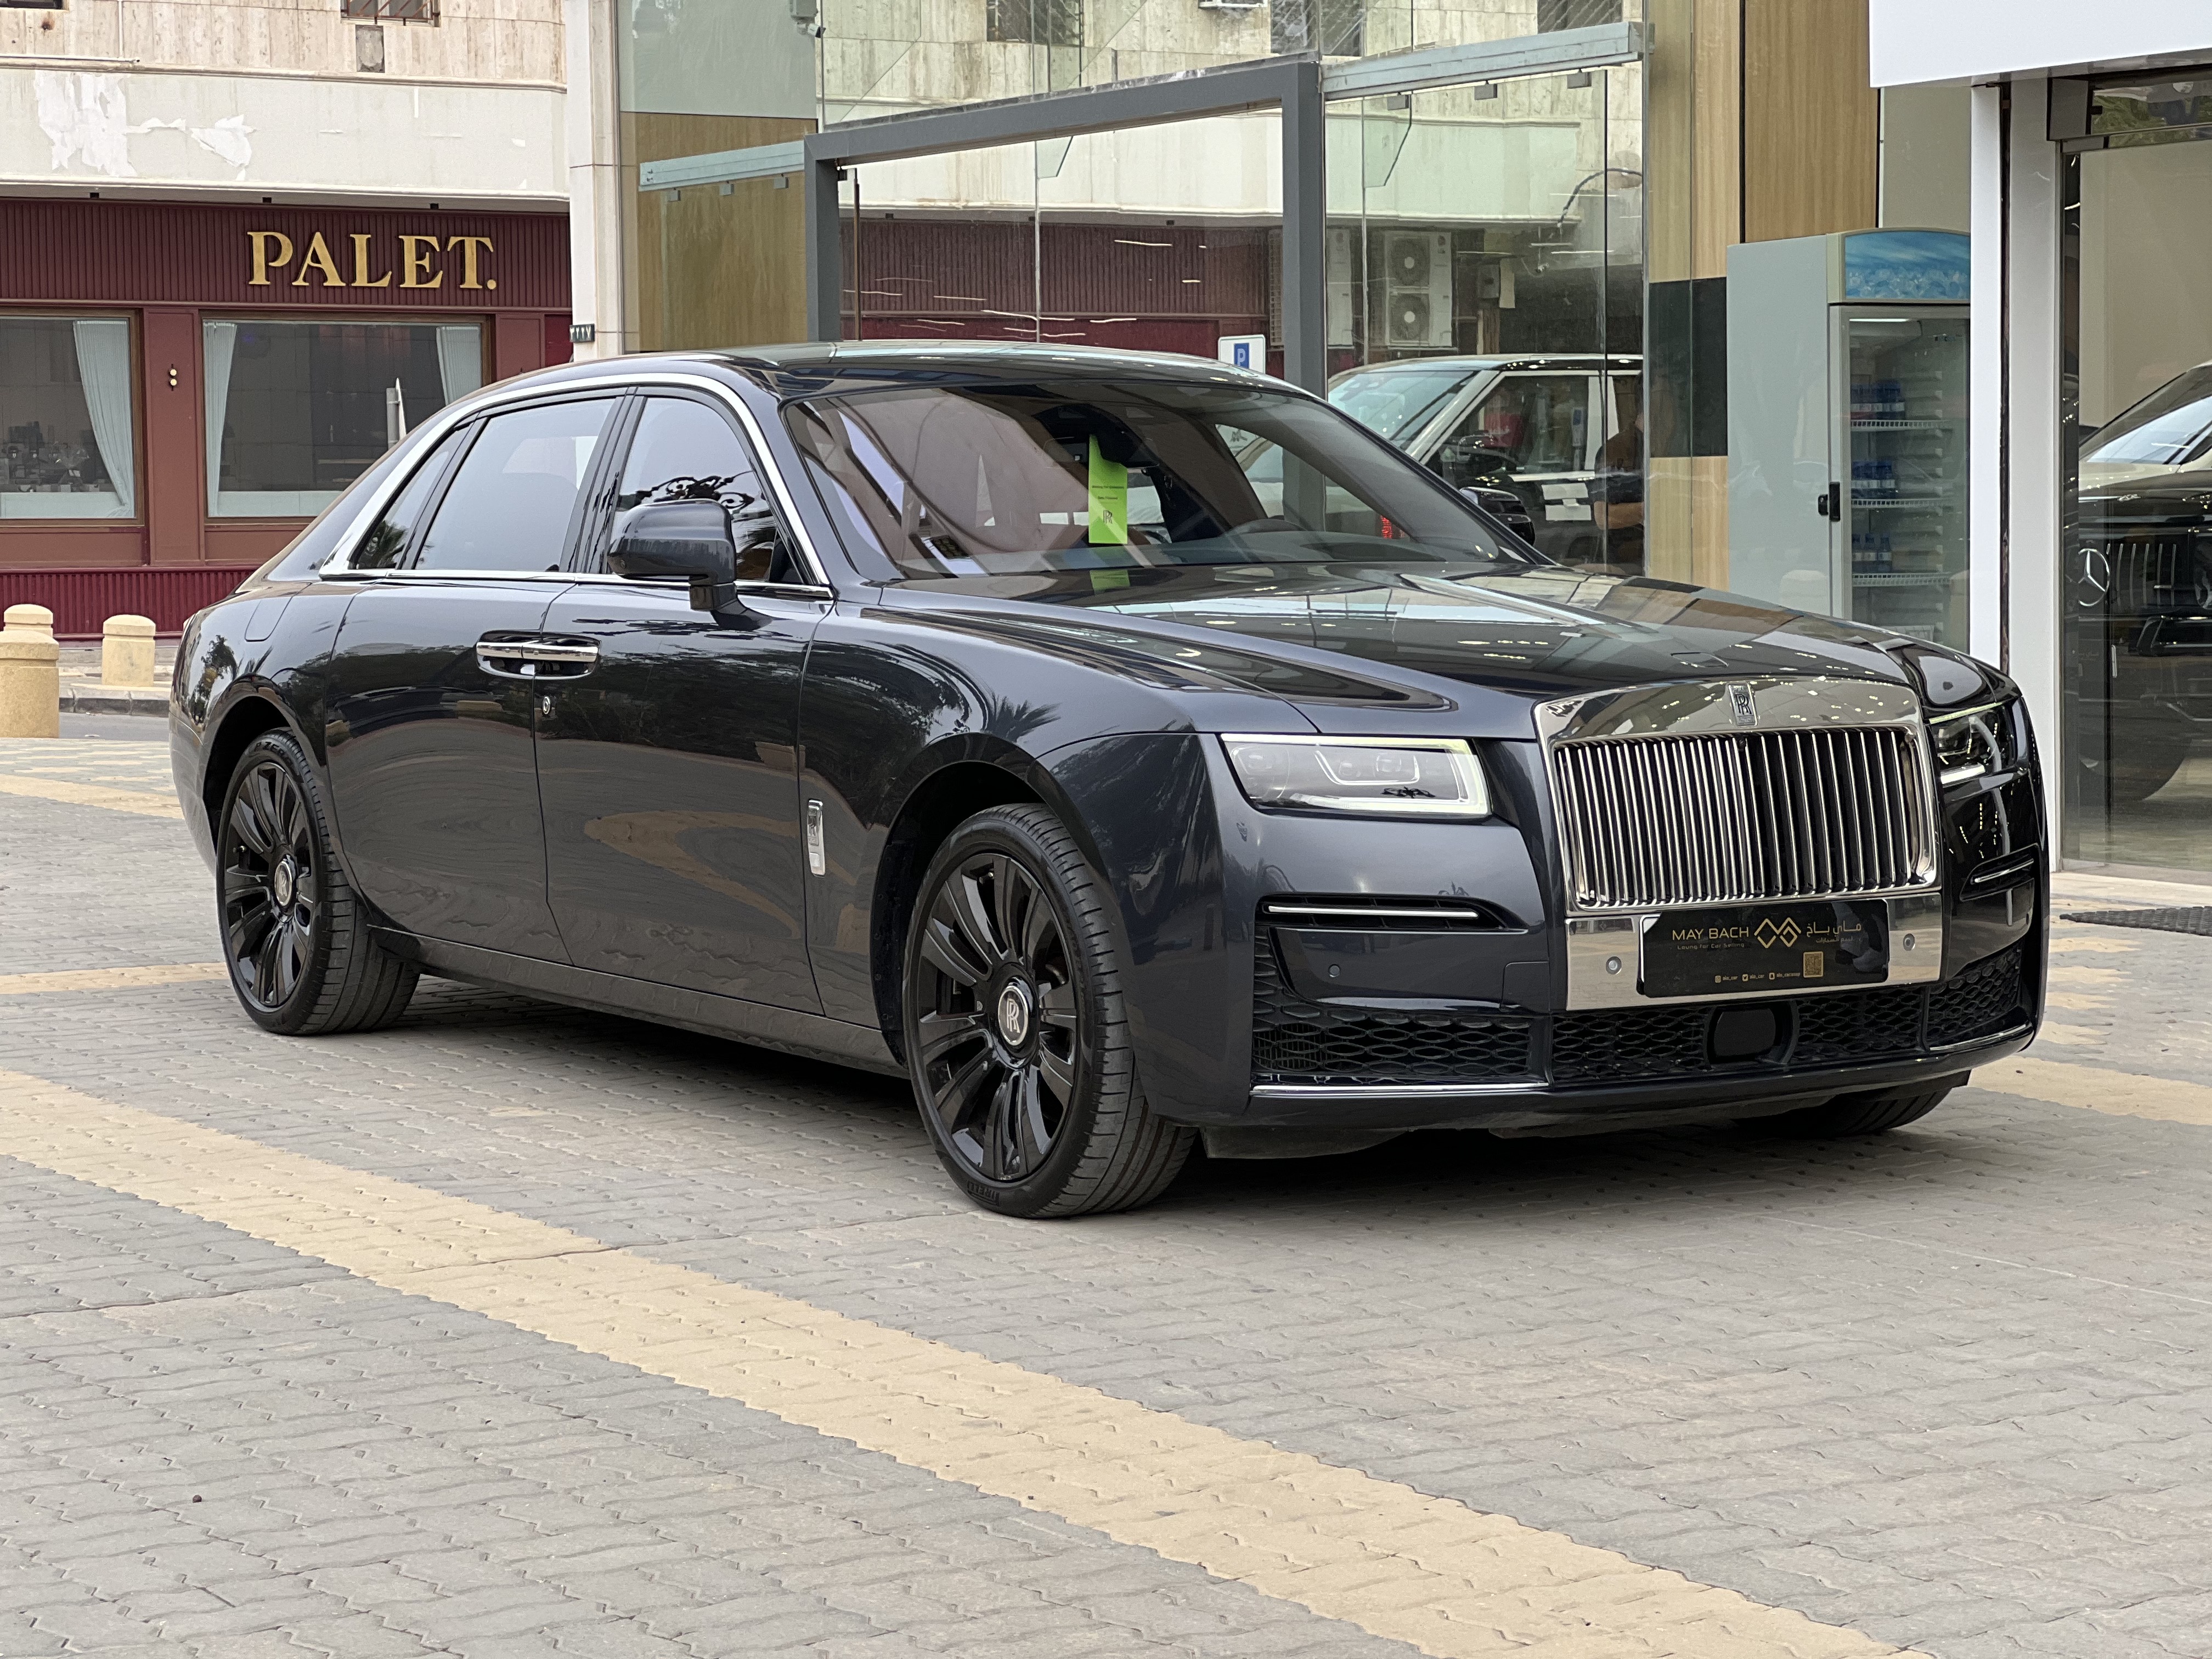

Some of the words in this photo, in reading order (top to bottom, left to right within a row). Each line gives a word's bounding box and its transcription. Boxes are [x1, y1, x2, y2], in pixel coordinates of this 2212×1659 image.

[247, 232, 496, 290] PALET.
[1237, 348, 1246, 367] P
[1672, 928, 1704, 941] MAY
[1708, 927, 1749, 939] BACH
